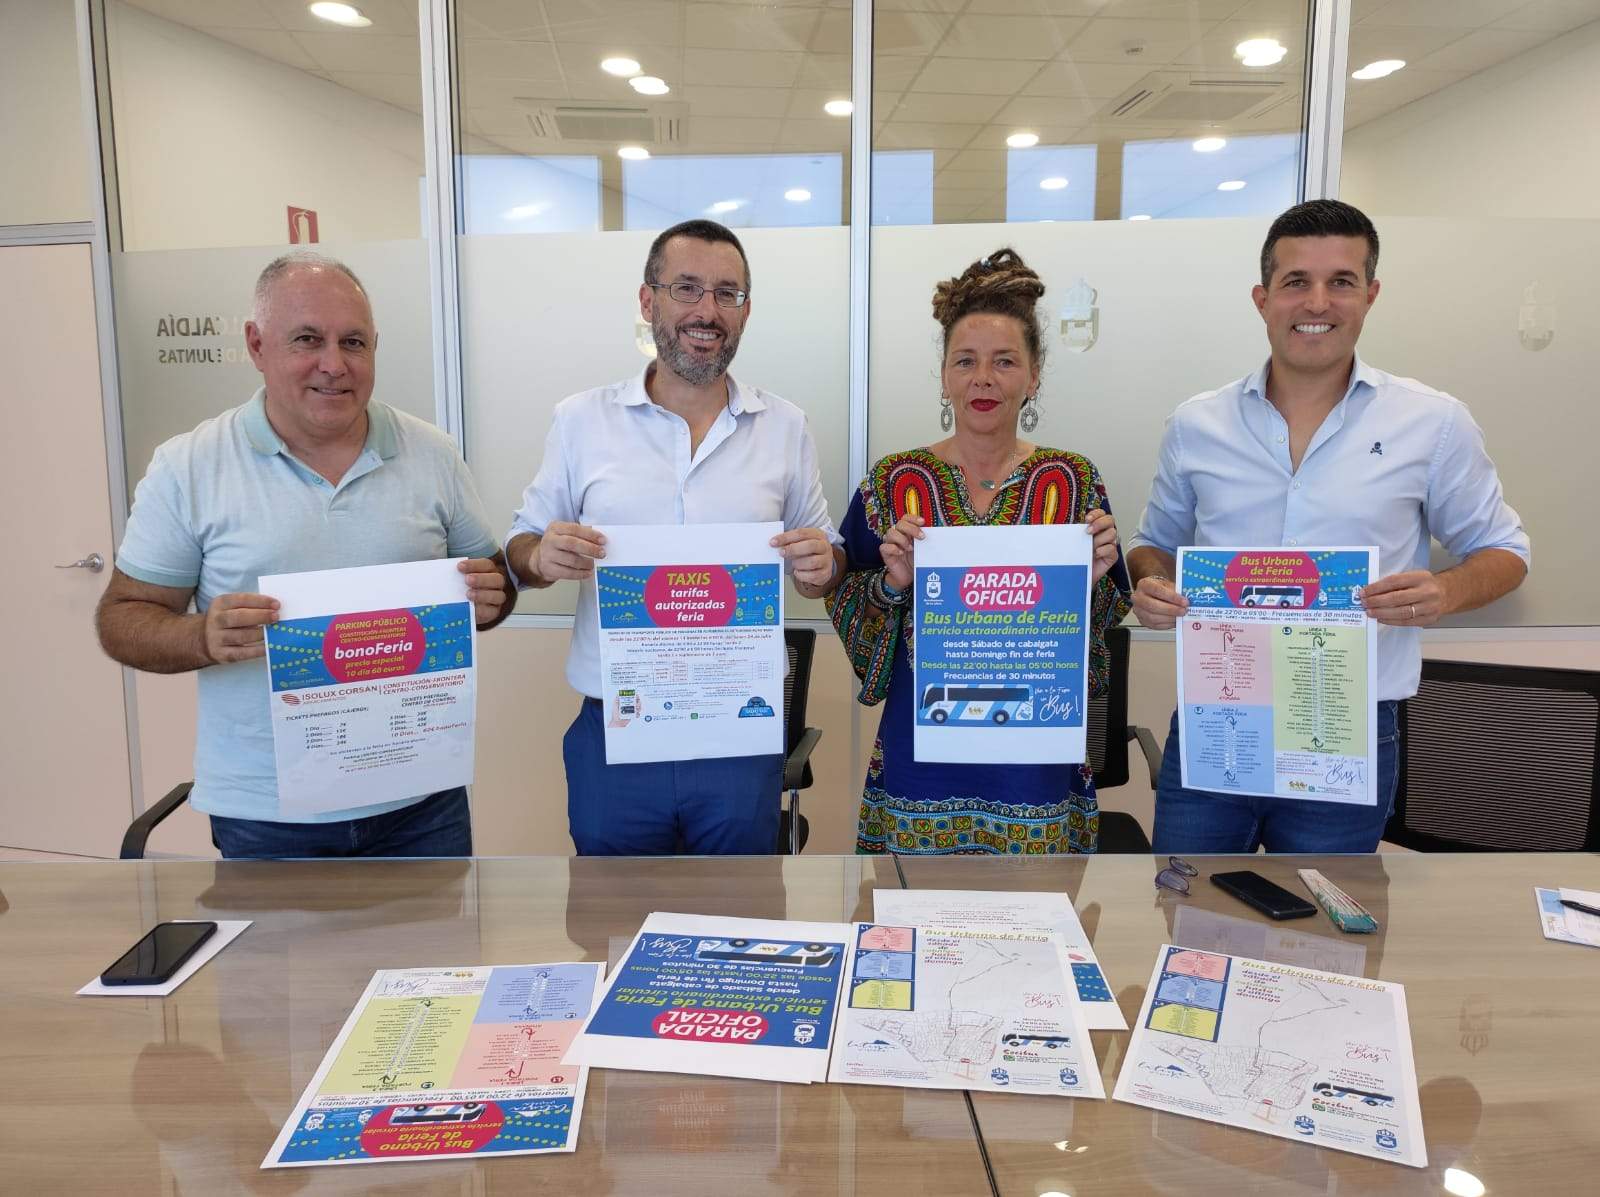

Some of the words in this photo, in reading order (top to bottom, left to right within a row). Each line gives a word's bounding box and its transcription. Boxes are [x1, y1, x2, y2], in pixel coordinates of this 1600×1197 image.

[1240, 556, 1261, 566] Bus
[1262, 556, 1303, 566] Urbano
[1250, 566, 1264, 575] de
[1266, 566, 1293, 576] Feria
[667, 573, 711, 585] TAXIS
[963, 572, 1037, 588] PARADA
[671, 588, 709, 598] tarifas
[965, 589, 1036, 606] OFICIAL
[655, 600, 725, 610] autorizadas
[677, 611, 704, 622] feria
[924, 611, 951, 624] Bus
[956, 611, 1013, 624] Urbano
[1017, 611, 1034, 624] de
[1039, 610, 1078, 624] Feria
[1271, 610, 1312, 618] Frecuencias
[335, 618, 373, 631] PARKING
[373, 616, 408, 629] PÚBLICO
[921, 626, 961, 636] servicio
[963, 626, 1039, 636] extraordinario
[1041, 625, 1080, 635] circular
[943, 640, 969, 648] desde
[971, 639, 1002, 648] Sábado
[1004, 640, 1016, 648] de
[1018, 640, 1059, 650] cabalgata
[335, 640, 413, 660] bonoFeria
[945, 650, 969, 658] hasta
[971, 650, 1007, 660] Domingo
[1009, 650, 1021, 658] fin
[1023, 650, 1034, 658] de
[1036, 650, 1055, 658] feria
[345, 659, 371, 670] precio
[372, 655, 404, 668] especial
[921, 662, 949, 670] Desde
[950, 662, 961, 670] las
[990, 662, 1013, 670] hasta
[1055, 661, 1079, 669] horas
[383, 665, 405, 674] euros
[943, 672, 993, 680] Frecuencias
[995, 672, 1007, 680] de
[1008, 672, 1021, 680] 30
[1022, 672, 1056, 680] minutos
[302, 690, 337, 701] ISOLUX
[339, 685, 378, 697] CORSÁN
[383, 680, 464, 696] CENTRO-CONSERVATORIO
[661, 961, 704, 969] minutos
[737, 965, 804, 975] Frecuencias
[718, 976, 765, 985] Domingo
[766, 980, 798, 988] hasta
[797, 975, 832, 983] Desde
[648, 980, 701, 989] cabalgata
[721, 984, 758, 994] Sábado
[616, 986, 668, 997] circular
[670, 989, 771, 1002] extraordinario
[764, 987, 800, 995] desde
[614, 994, 668, 1006] Feria
[671, 998, 696, 1007] de
[774, 996, 828, 1005] servicio
[702, 999, 779, 1013] Urbano
[785, 1004, 823, 1015] Bus
[667, 1010, 762, 1027] OFICIAL
[658, 1023, 762, 1040] PARADA
[528, 1090, 568, 1098] Horarios
[317, 1100, 355, 1108] minutos
[391, 1096, 444, 1104] Frecuencias
[363, 1127, 397, 1135] circular
[398, 1123, 466, 1131] extraordinario
[397, 1132, 438, 1142] Feria
[442, 1131, 461, 1140] de
[378, 1141, 440, 1152] Urbano
[446, 1138, 473, 1149] Bus
